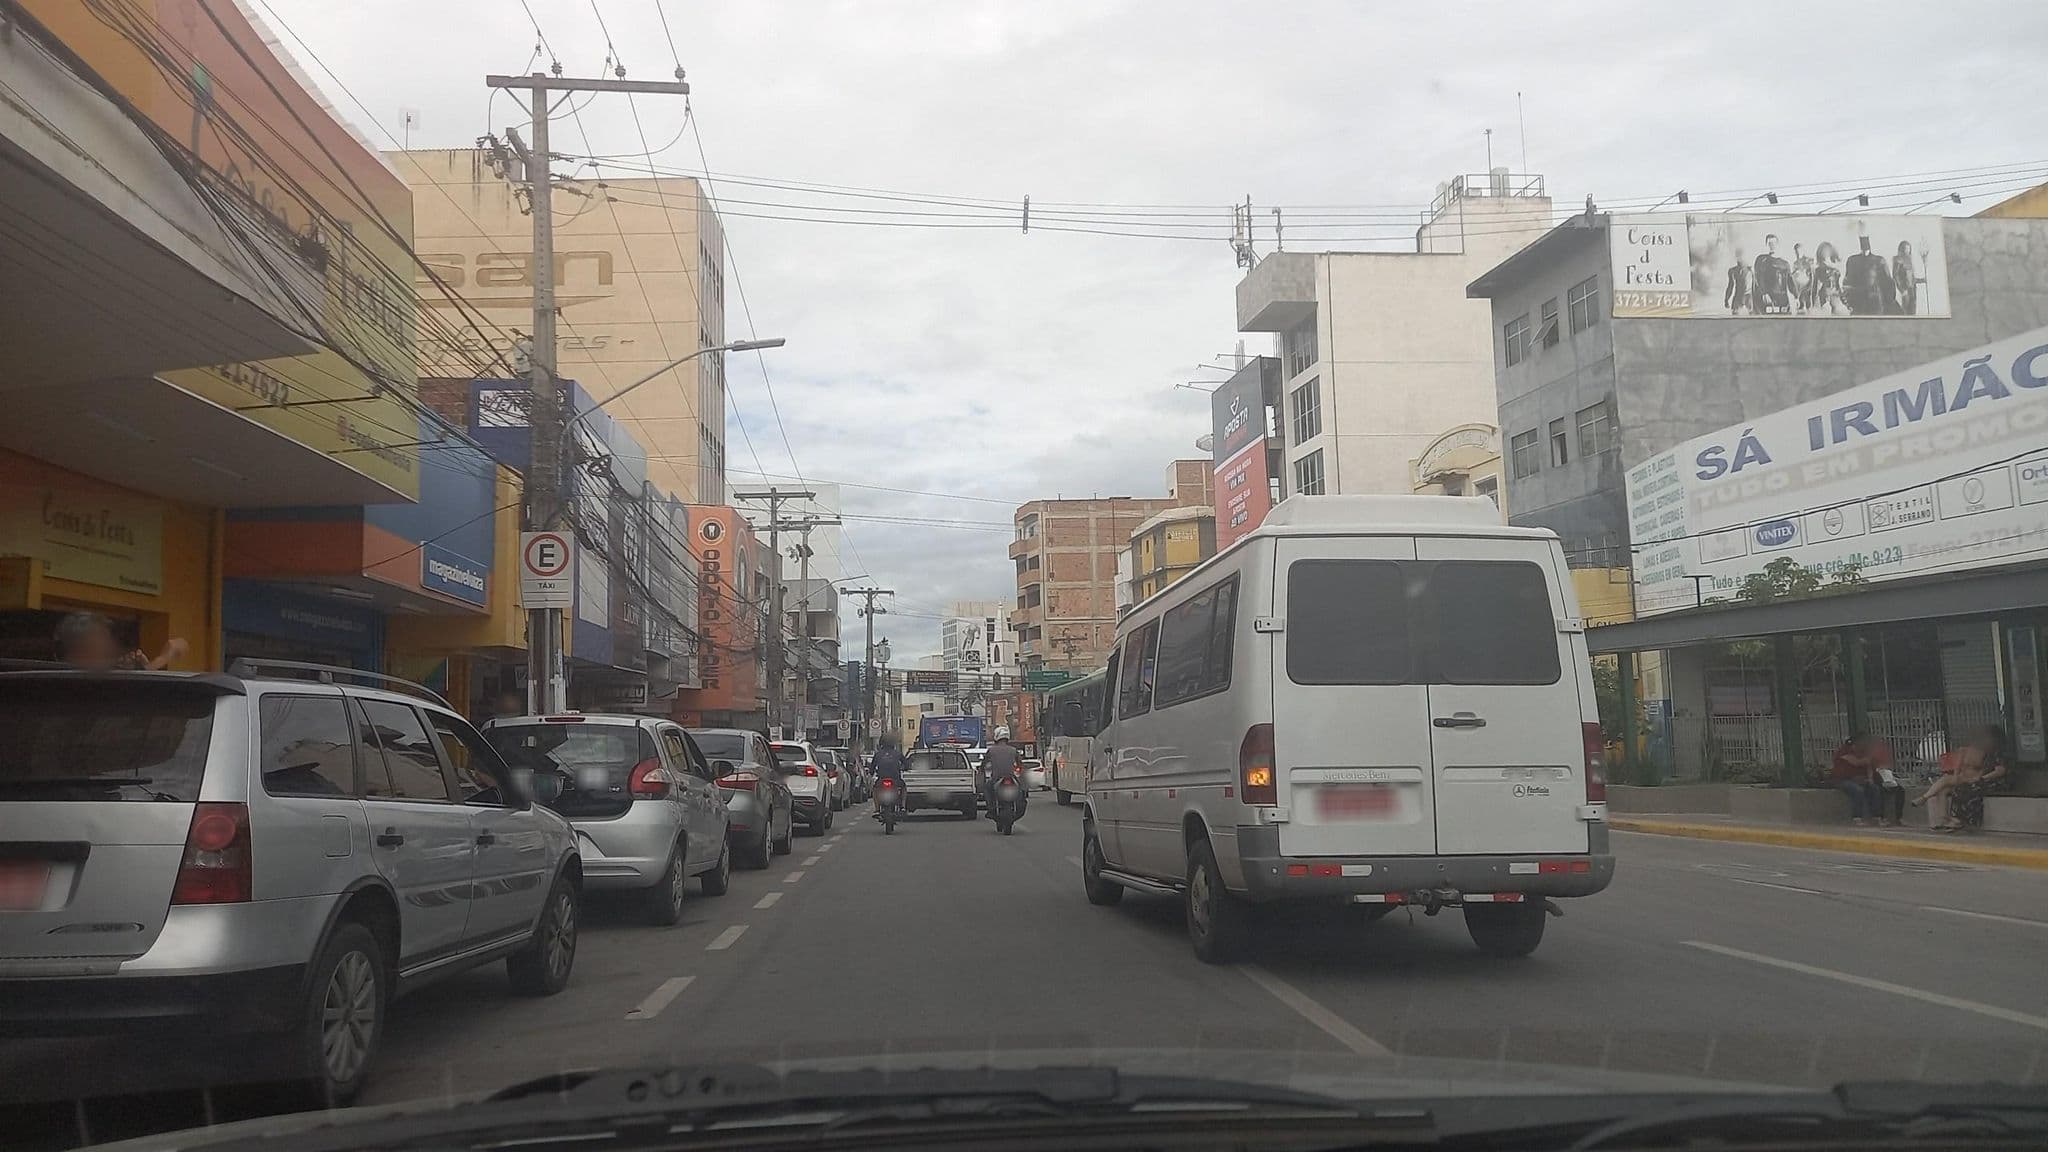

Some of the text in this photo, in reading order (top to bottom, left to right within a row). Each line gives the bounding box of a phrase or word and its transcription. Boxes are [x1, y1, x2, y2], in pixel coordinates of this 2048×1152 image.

[1628, 225, 1673, 246] Coisa
[1639, 249, 1650, 263] d
[1626, 265, 1673, 285] Festa
[1615, 293, 1689, 308] 3721-7622
[1695, 427, 1772, 481] SÁ
[1889, 496, 1931, 512] TEXTIL
[1758, 525, 1794, 541] VINITEX
[538, 543, 555, 567] E
[428, 558, 484, 592] magazineluiza
[1710, 575, 1733, 591] Tudo
[537, 580, 556, 590] TÁXI
